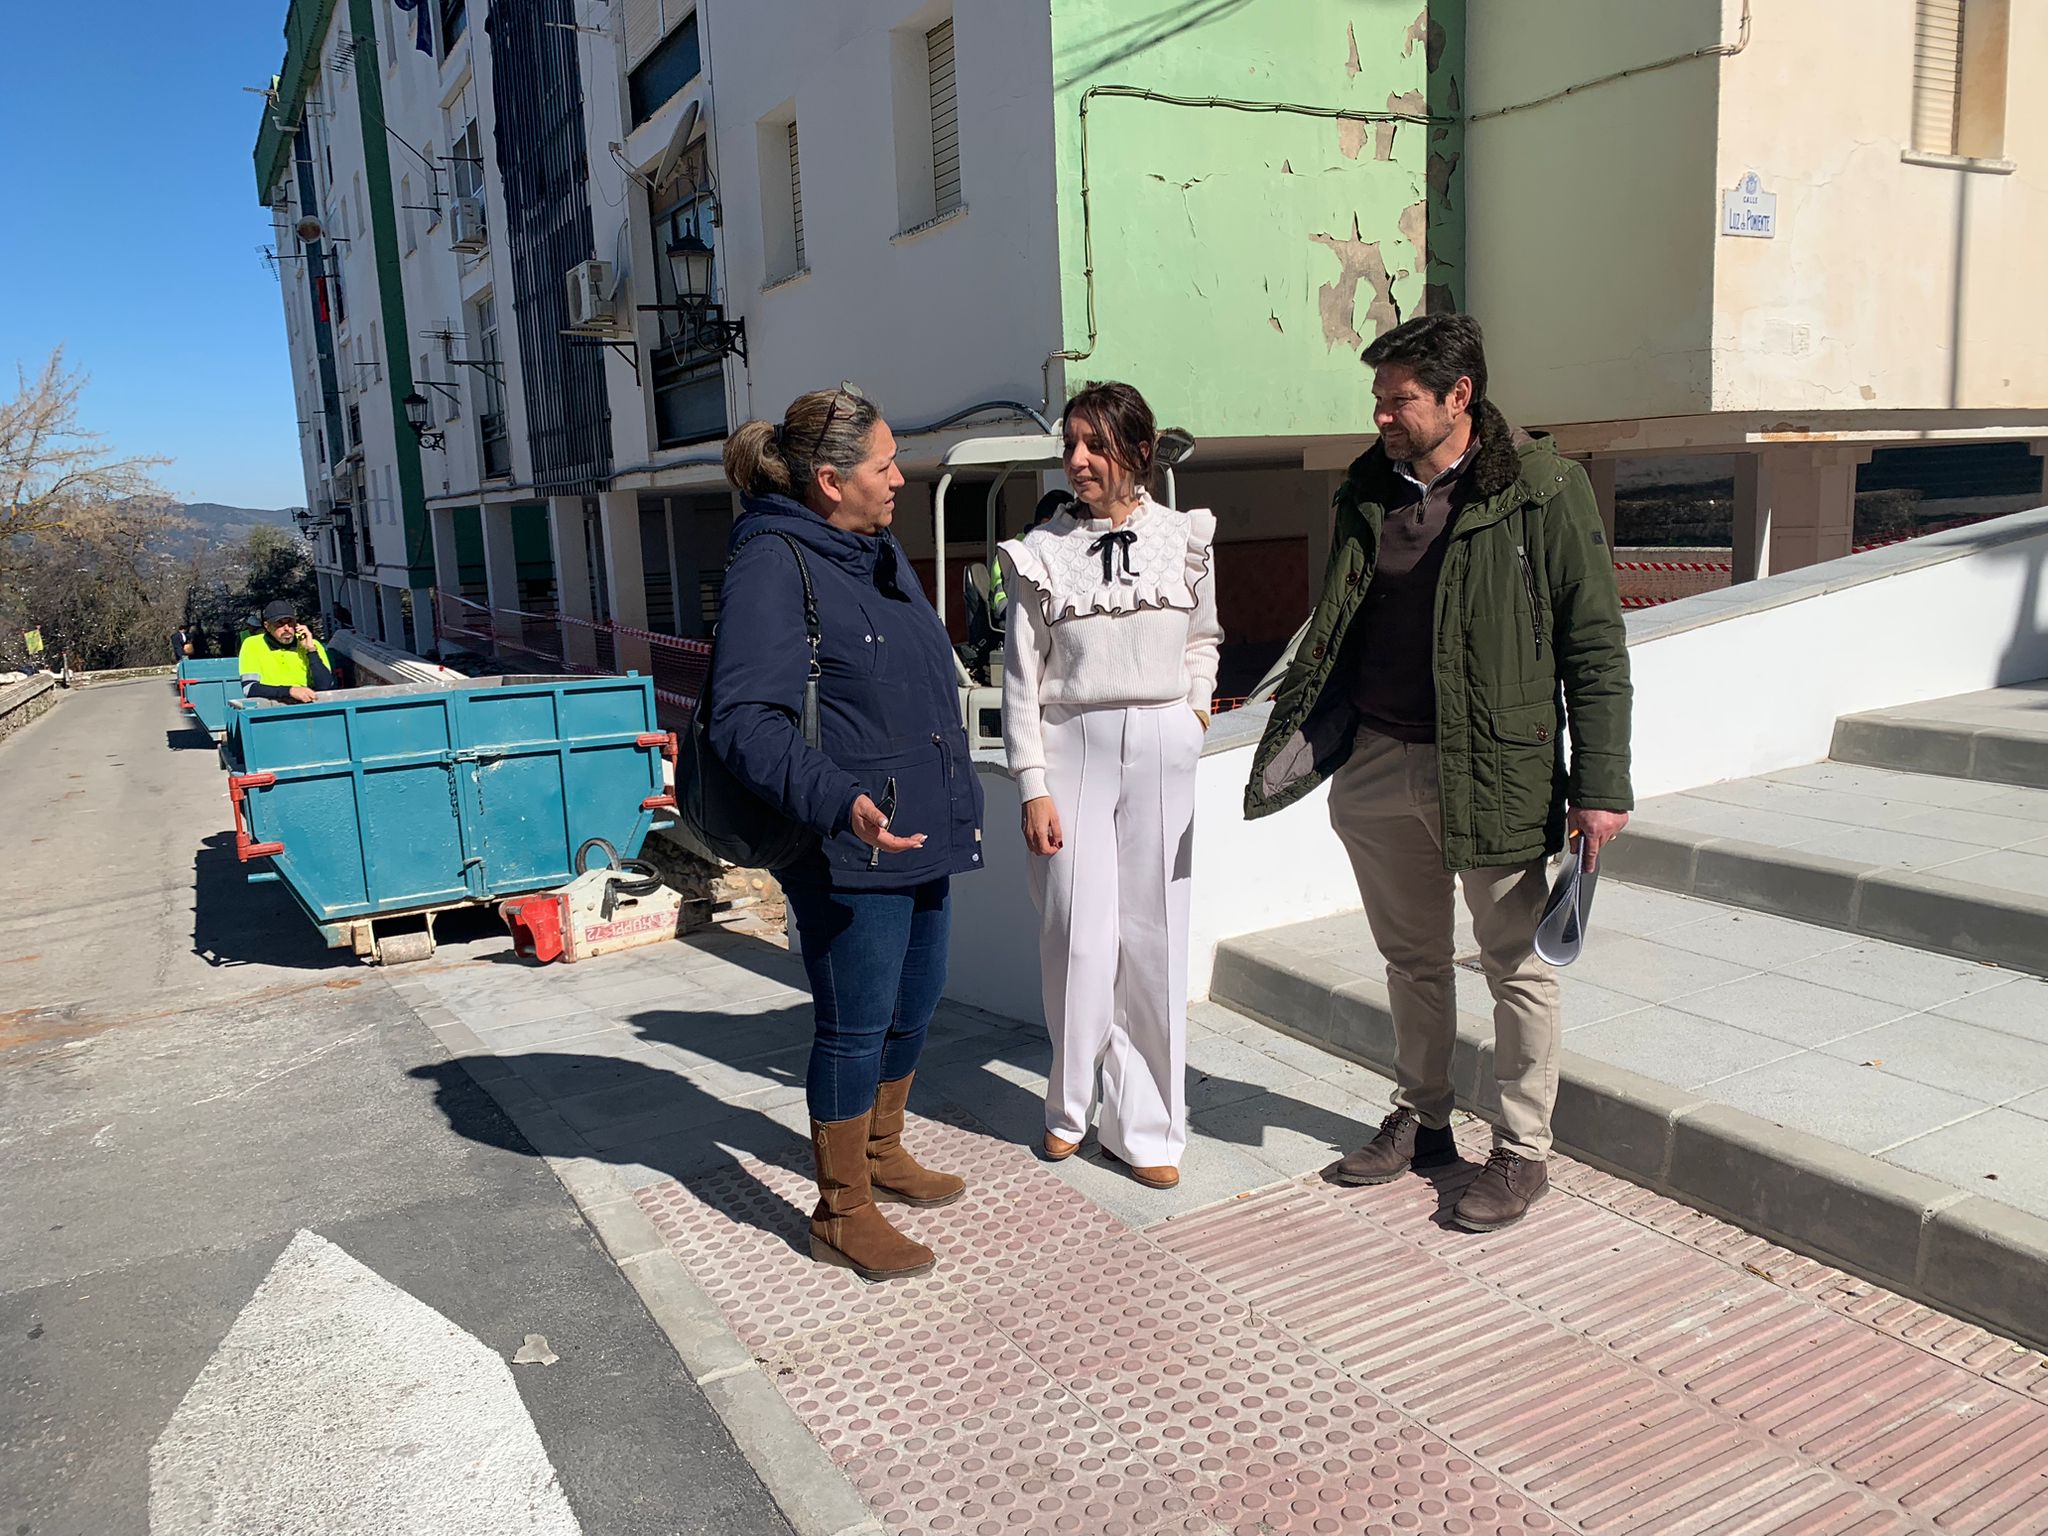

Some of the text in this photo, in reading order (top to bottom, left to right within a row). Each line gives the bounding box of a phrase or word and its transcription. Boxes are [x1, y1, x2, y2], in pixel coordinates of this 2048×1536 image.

[1743, 196, 1758, 204] CALLE
[1729, 208, 1740, 229] LUZ
[587, 927, 603, 941] 72
